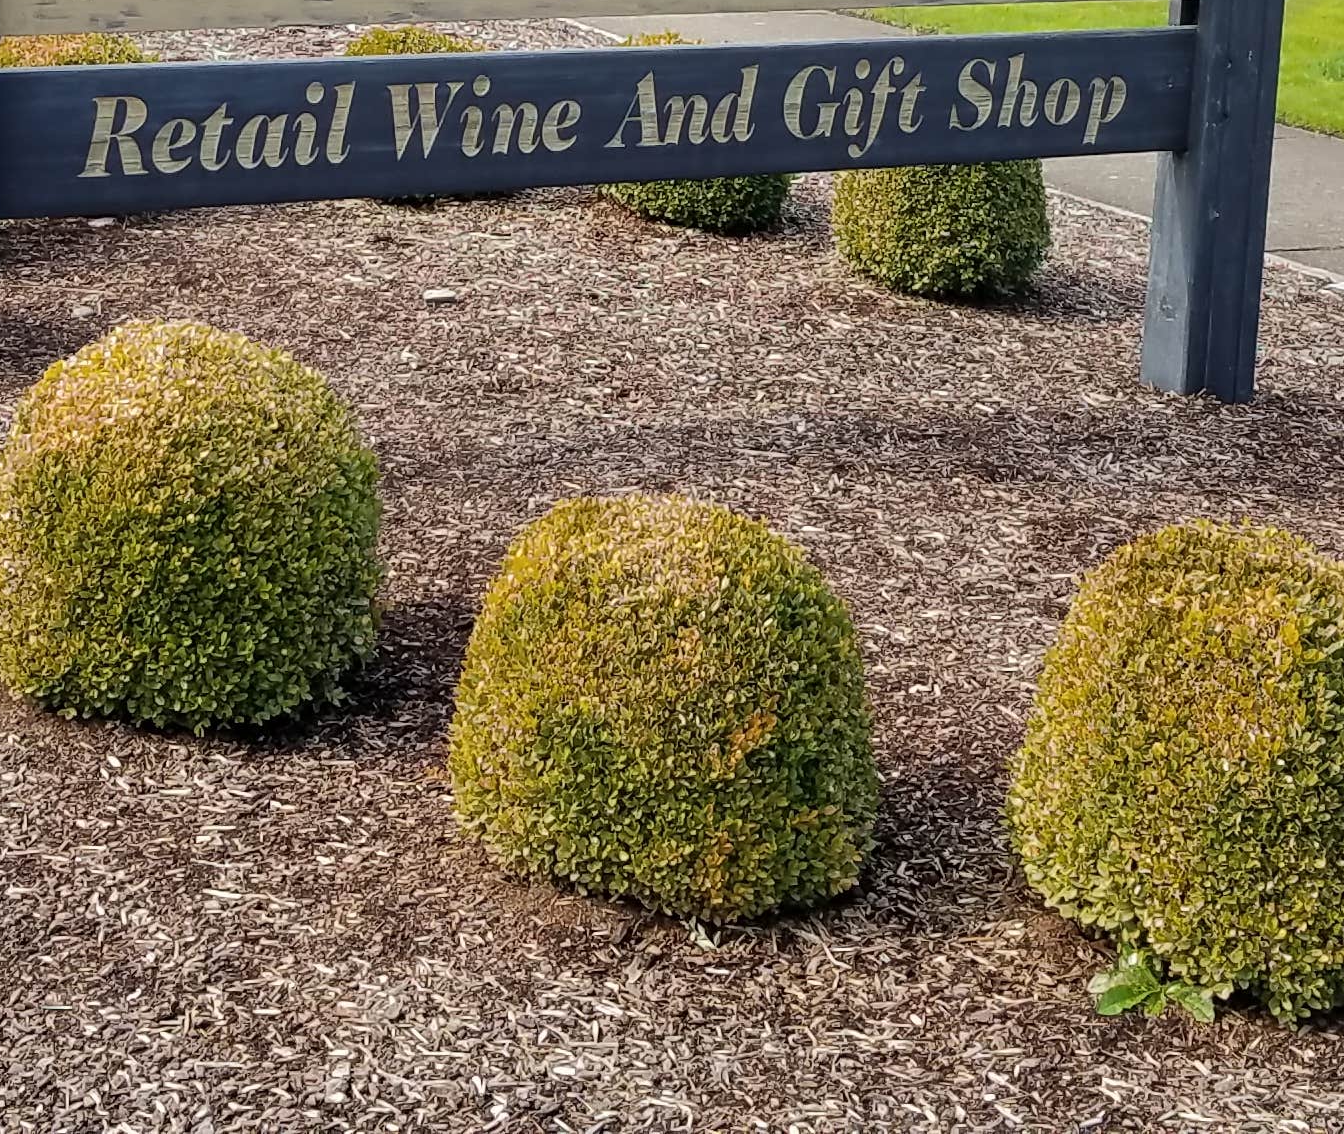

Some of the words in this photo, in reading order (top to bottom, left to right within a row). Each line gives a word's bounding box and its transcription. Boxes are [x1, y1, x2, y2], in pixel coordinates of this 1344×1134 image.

[76, 80, 356, 179] Retail
[386, 73, 582, 163] Wine
[603, 63, 760, 149] And
[782, 55, 927, 159] Gift
[948, 52, 1128, 146] Shop
